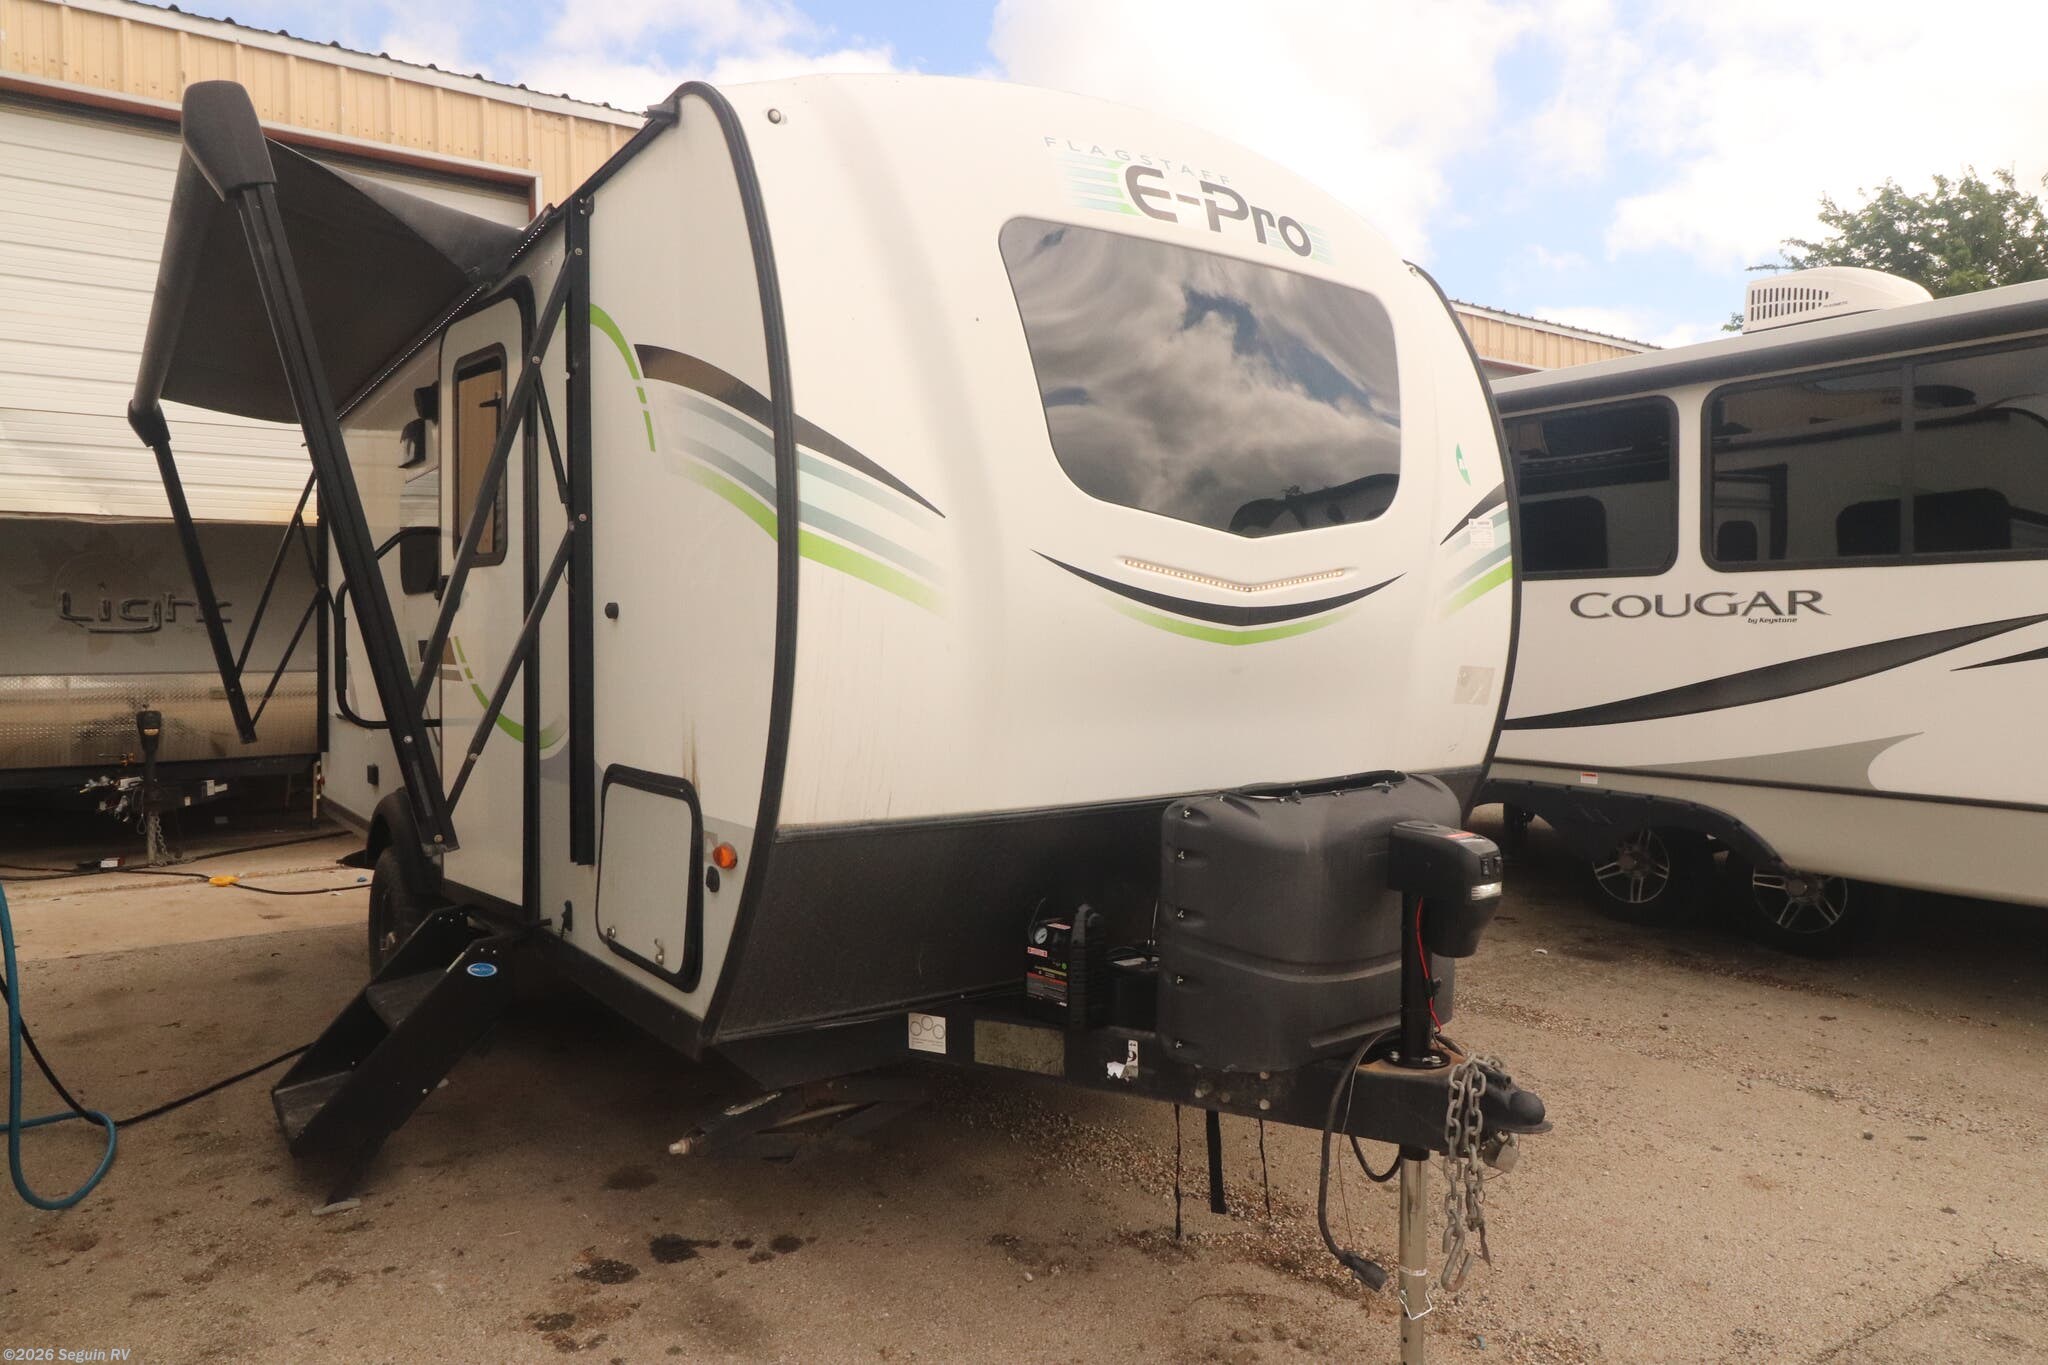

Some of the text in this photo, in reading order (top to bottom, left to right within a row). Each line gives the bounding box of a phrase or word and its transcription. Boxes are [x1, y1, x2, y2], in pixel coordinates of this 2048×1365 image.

[1044, 136, 1231, 185] FLAGSTAFF
[1125, 164, 1312, 257] E-Pro
[1569, 589, 1832, 619] COUGAR
[1747, 617, 1798, 625] by Keystone
